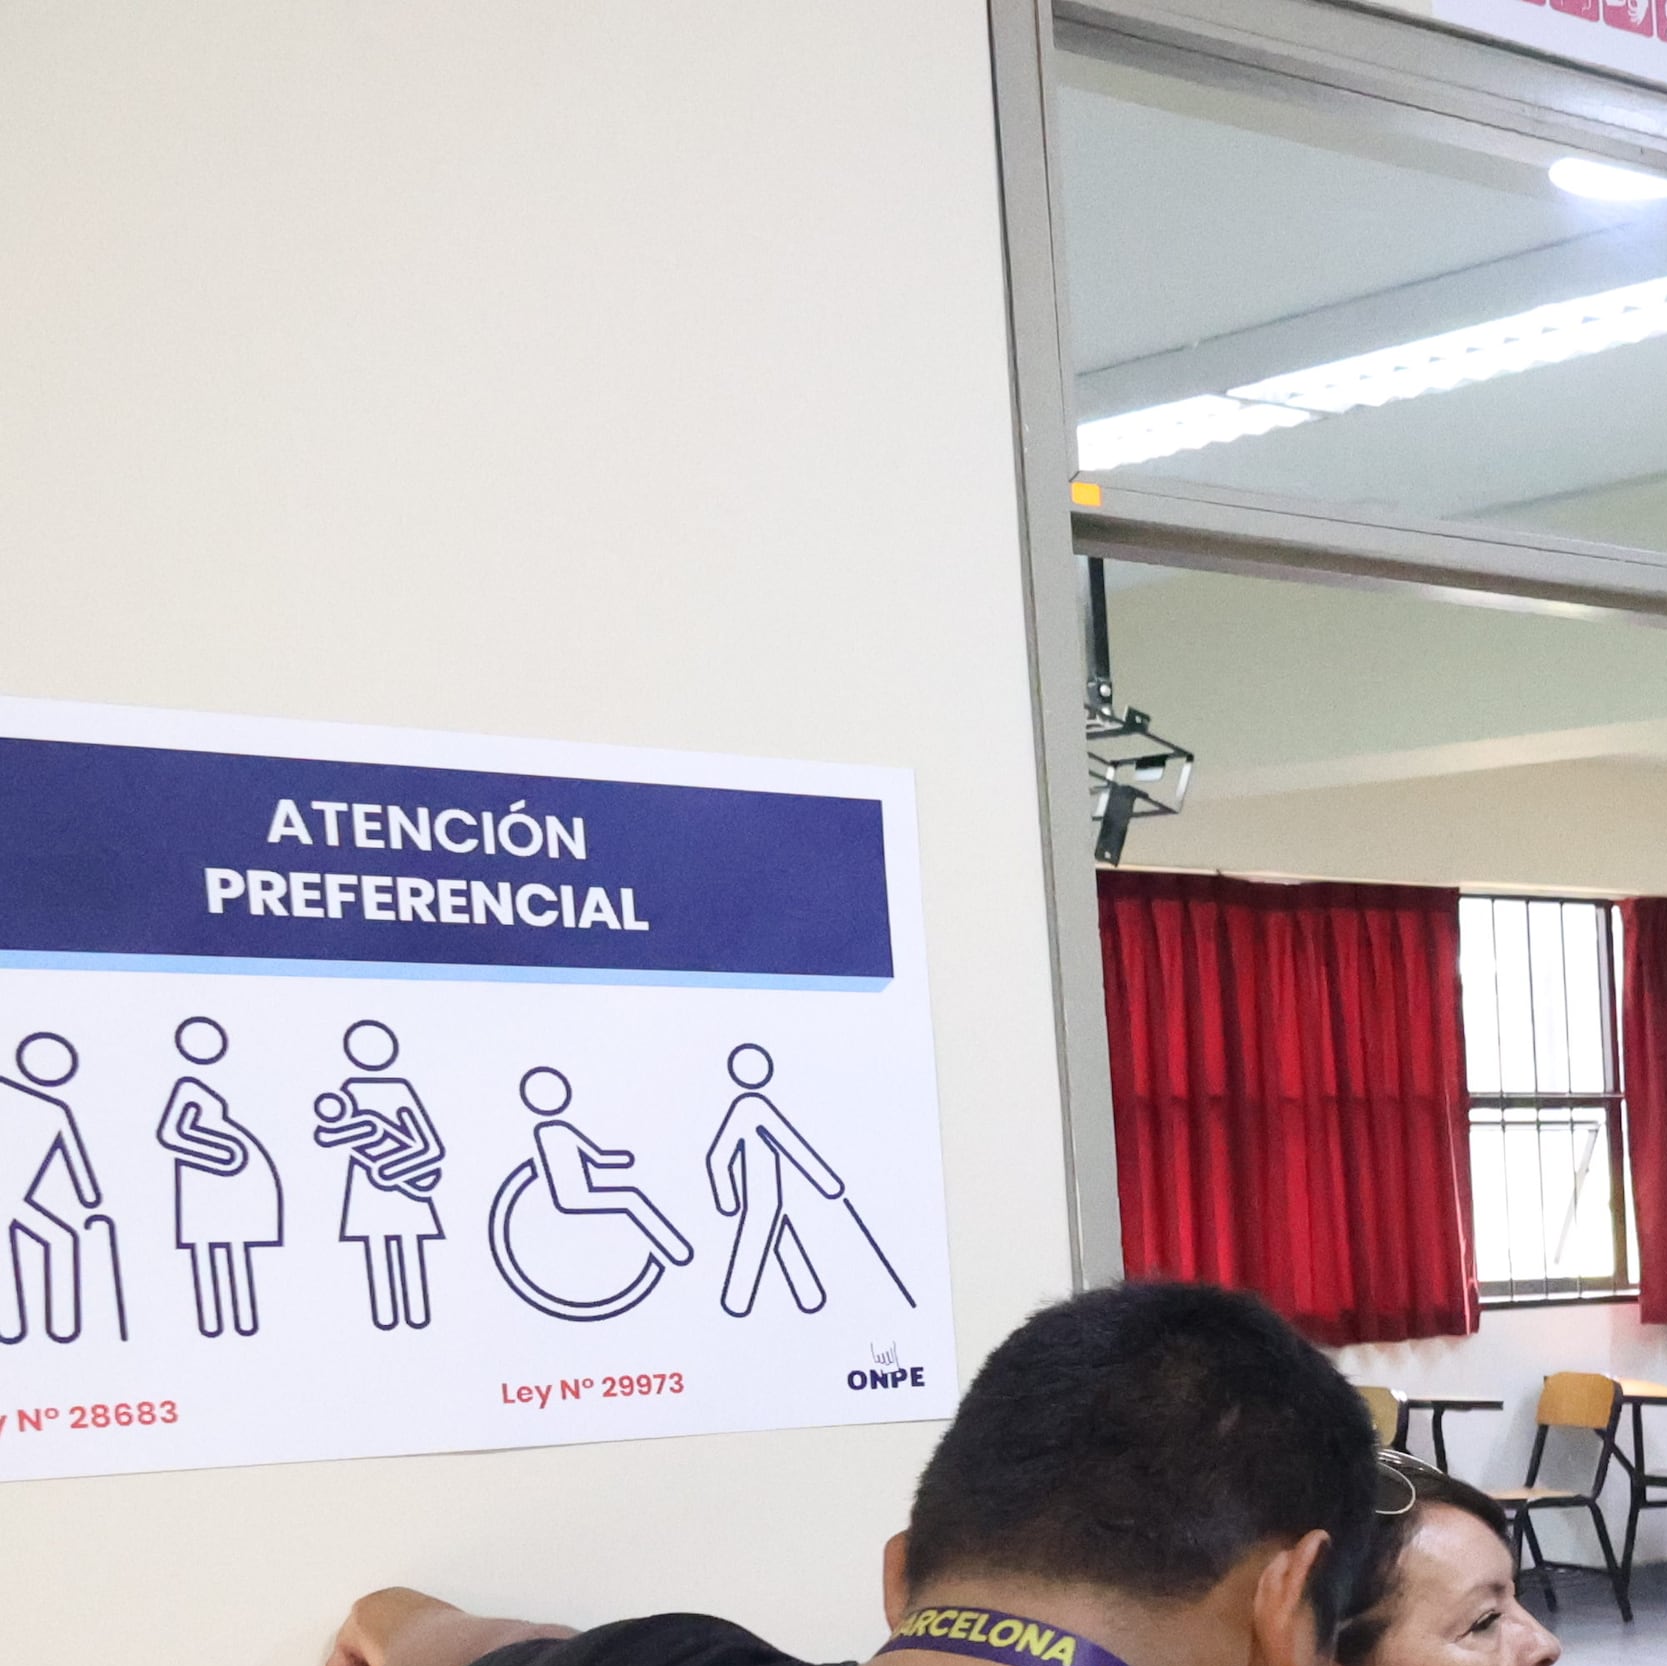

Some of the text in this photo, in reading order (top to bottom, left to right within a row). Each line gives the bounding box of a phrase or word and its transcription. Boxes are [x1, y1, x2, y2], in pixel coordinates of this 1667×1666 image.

[267, 798, 587, 861] ATENCIÓN
[205, 867, 649, 932] PREFERENCIAL
[501, 1382, 552, 1409] Ley
[602, 1372, 684, 1397] 29973
[847, 1366, 925, 1390] ONPE
[69, 1400, 178, 1428] 28683
